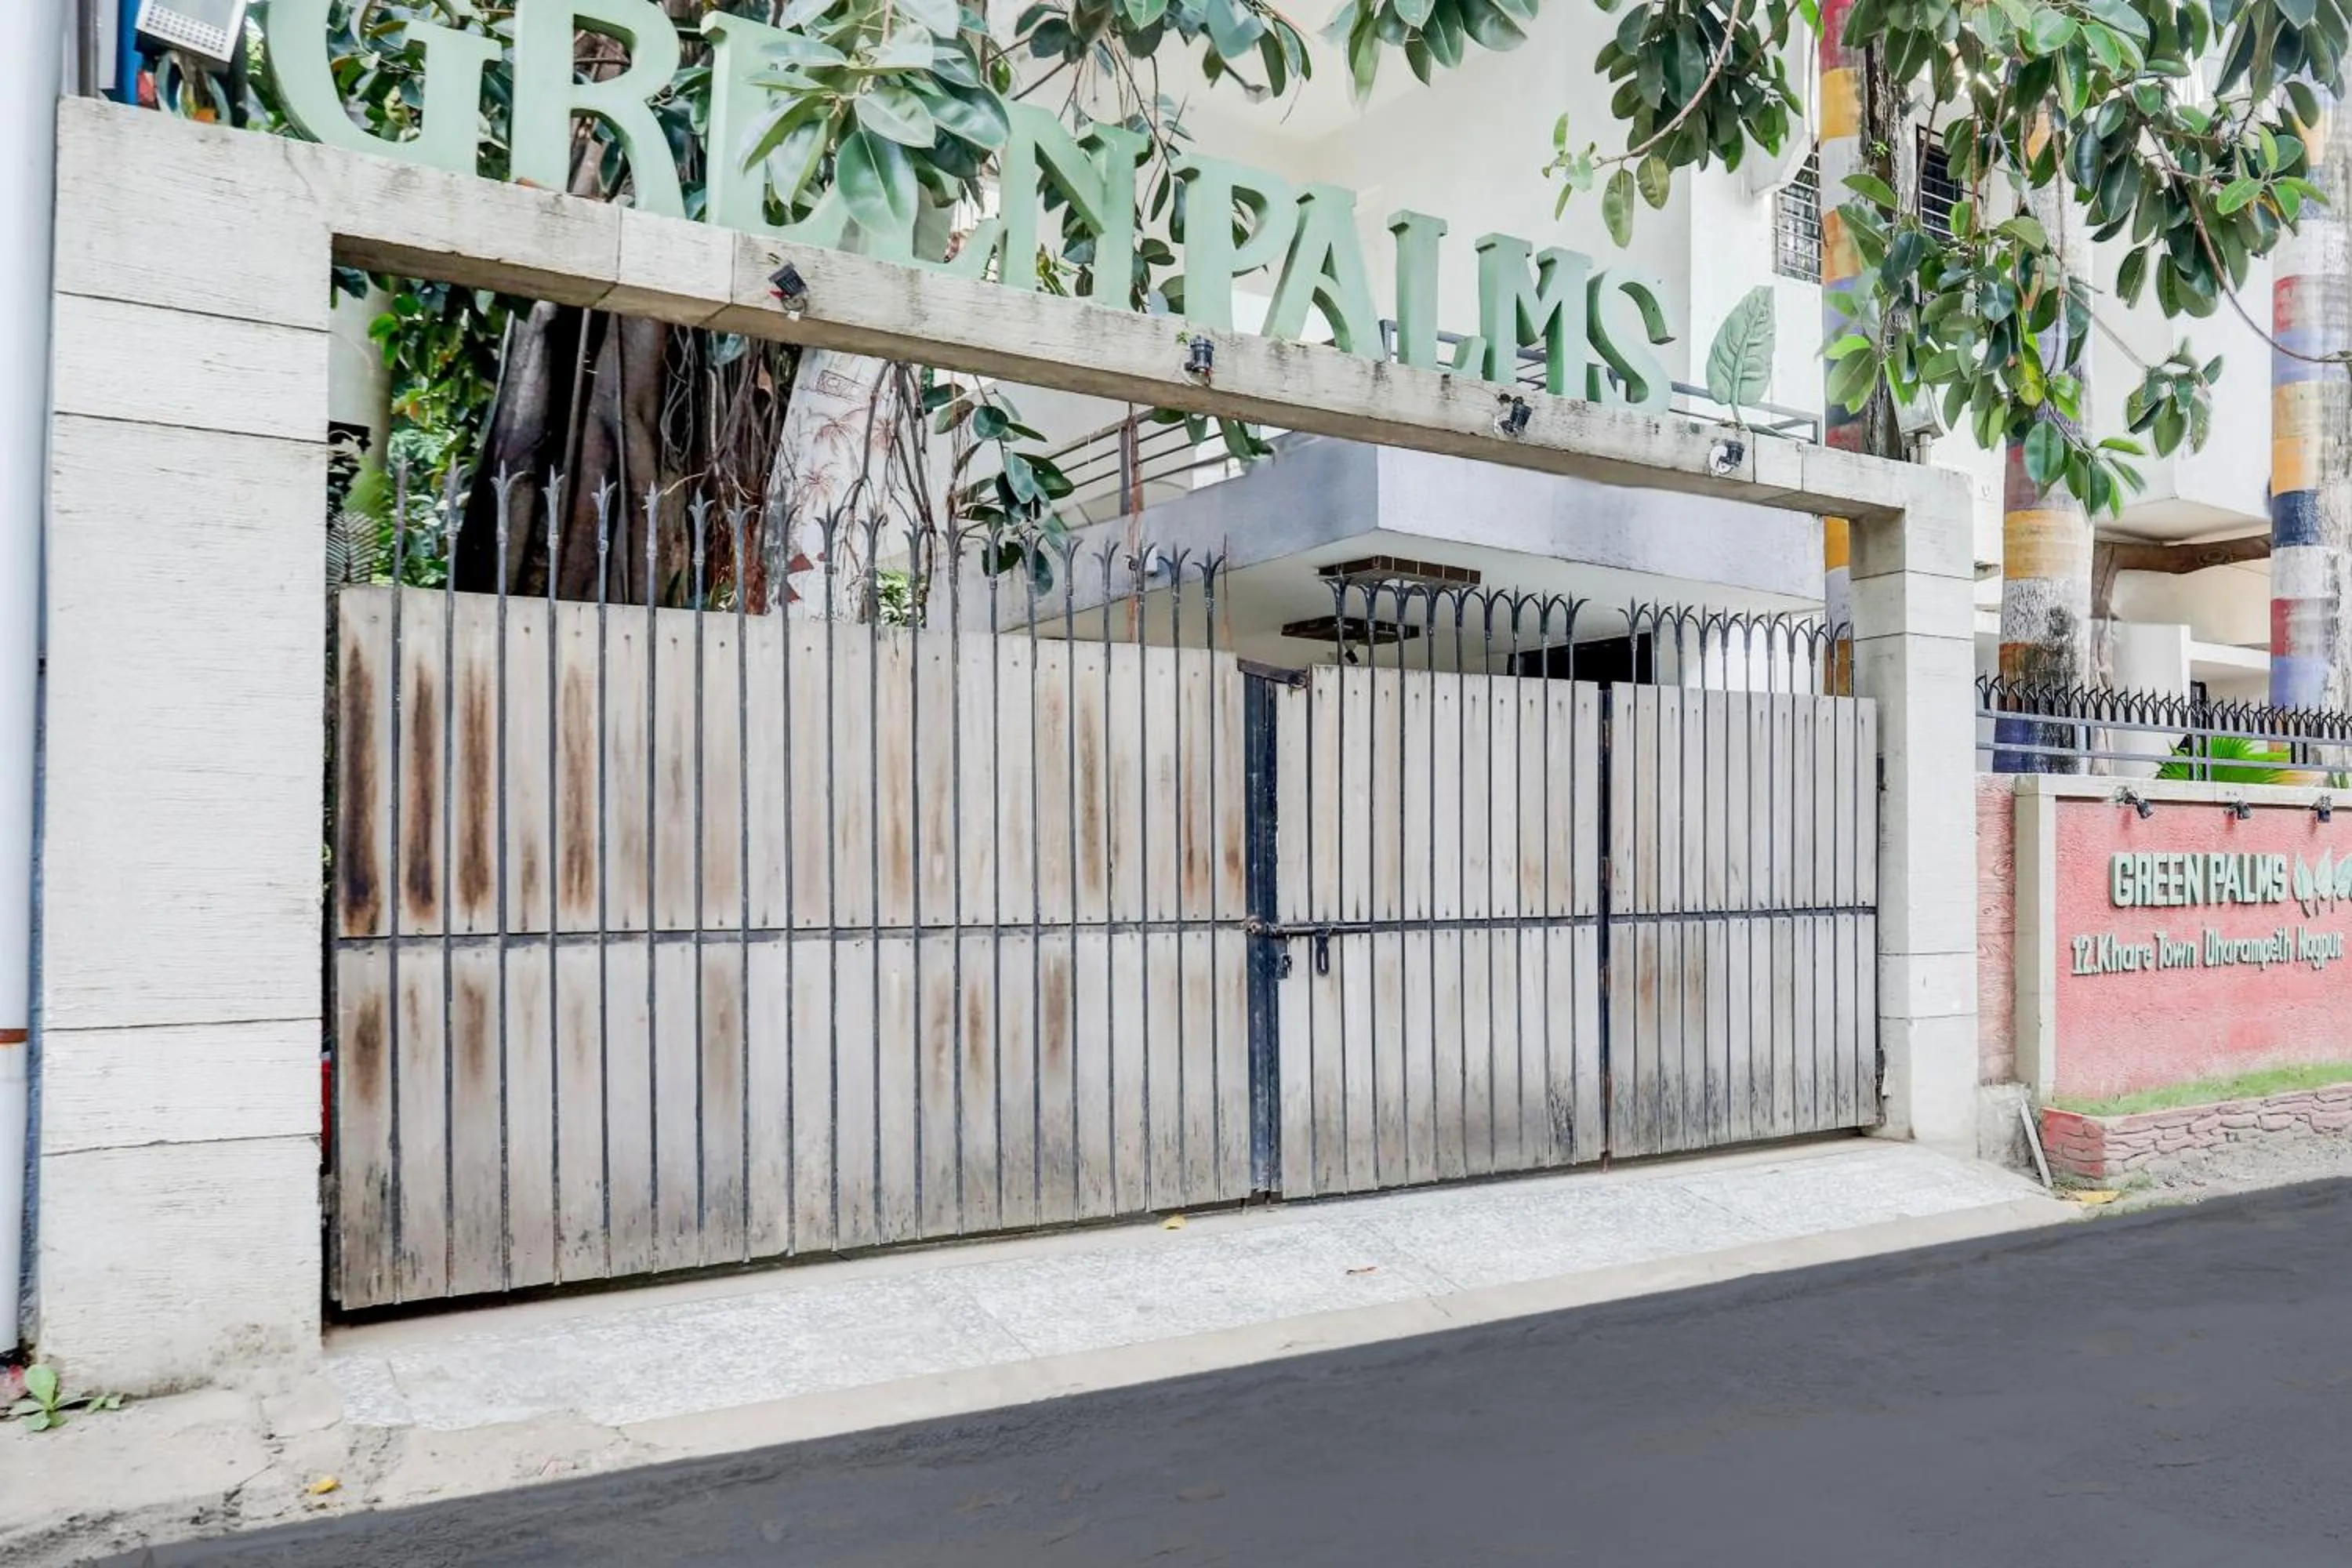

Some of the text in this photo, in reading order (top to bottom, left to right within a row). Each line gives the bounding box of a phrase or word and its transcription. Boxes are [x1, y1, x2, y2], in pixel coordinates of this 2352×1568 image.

[264, 0, 1674, 412] GREN PALMS
[2111, 852, 2287, 907] GREEN PALMS
[2154, 931, 2195, 970] Town
